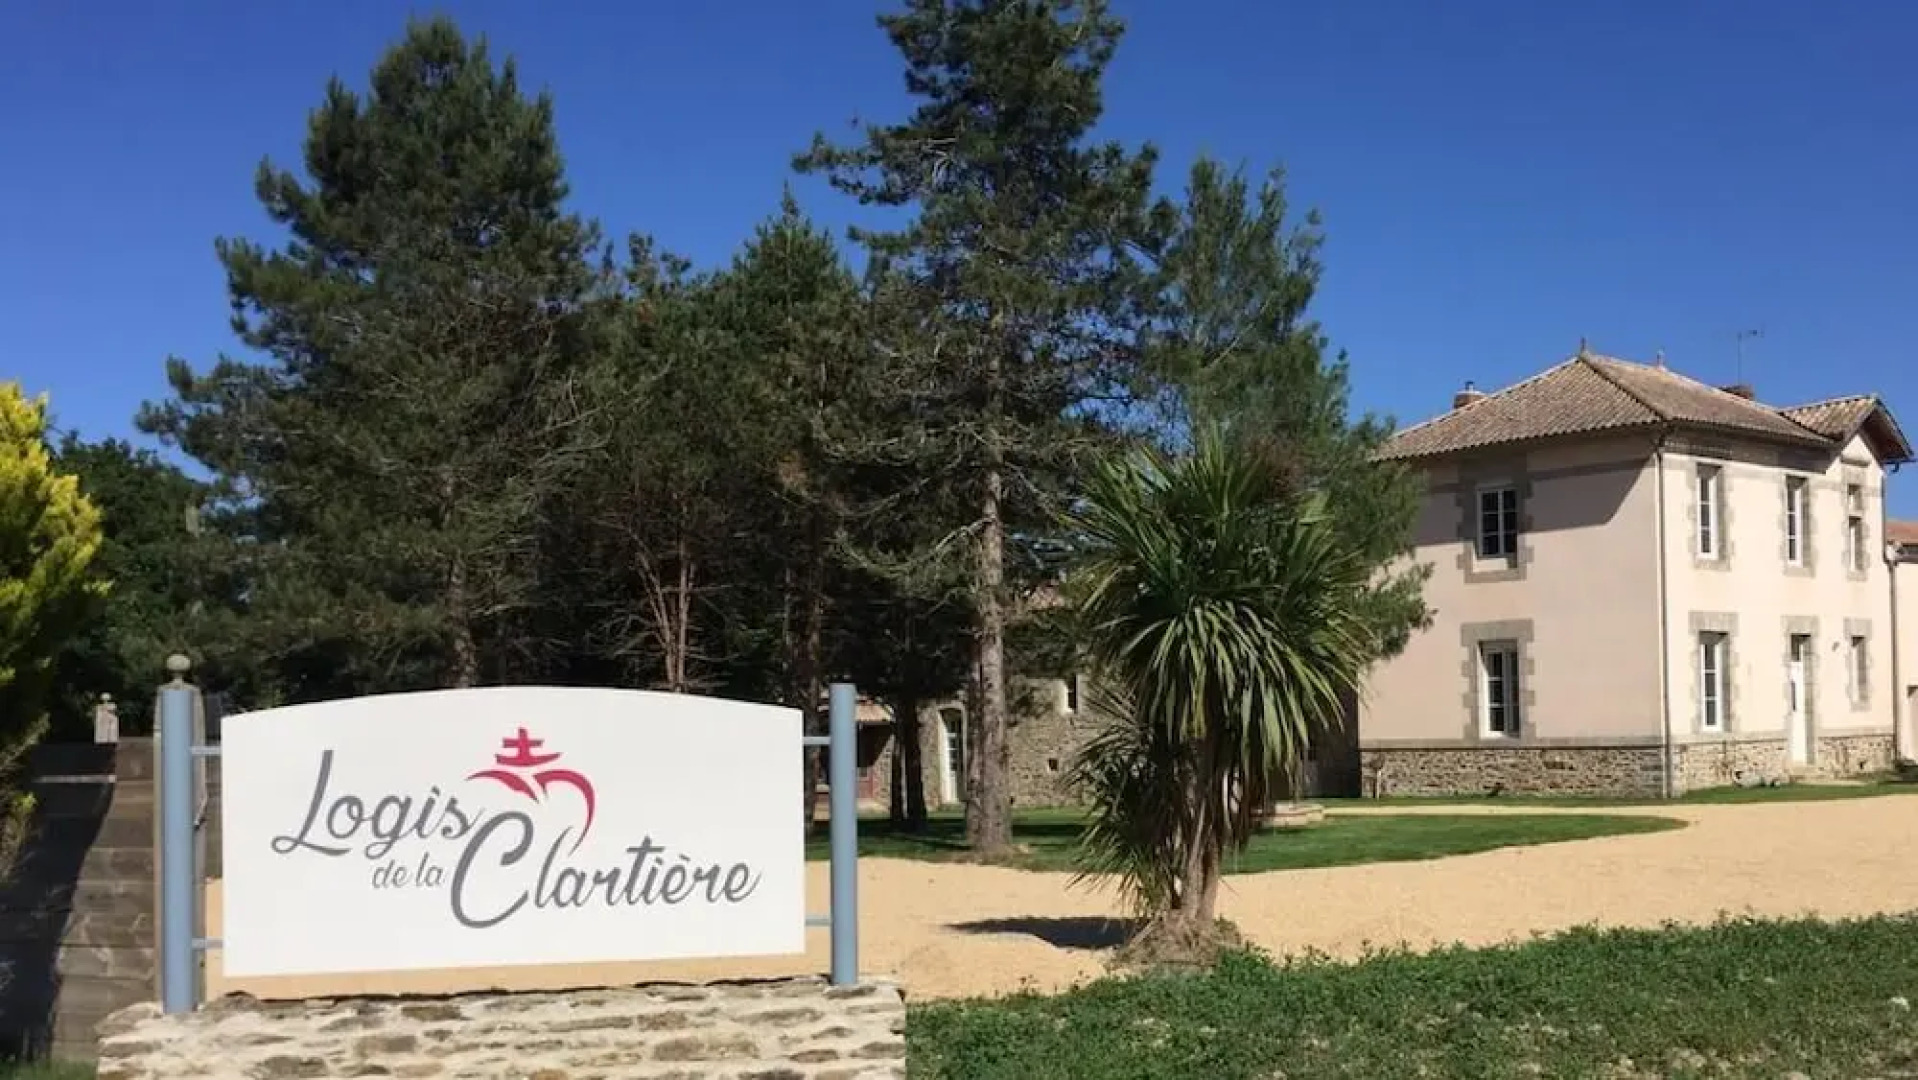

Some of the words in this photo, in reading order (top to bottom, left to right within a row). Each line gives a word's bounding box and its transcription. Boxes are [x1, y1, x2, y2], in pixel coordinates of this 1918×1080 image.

[271, 749, 484, 860] Logis
[371, 862, 410, 888] de
[415, 852, 446, 888] la
[450, 811, 762, 929] Clartière
